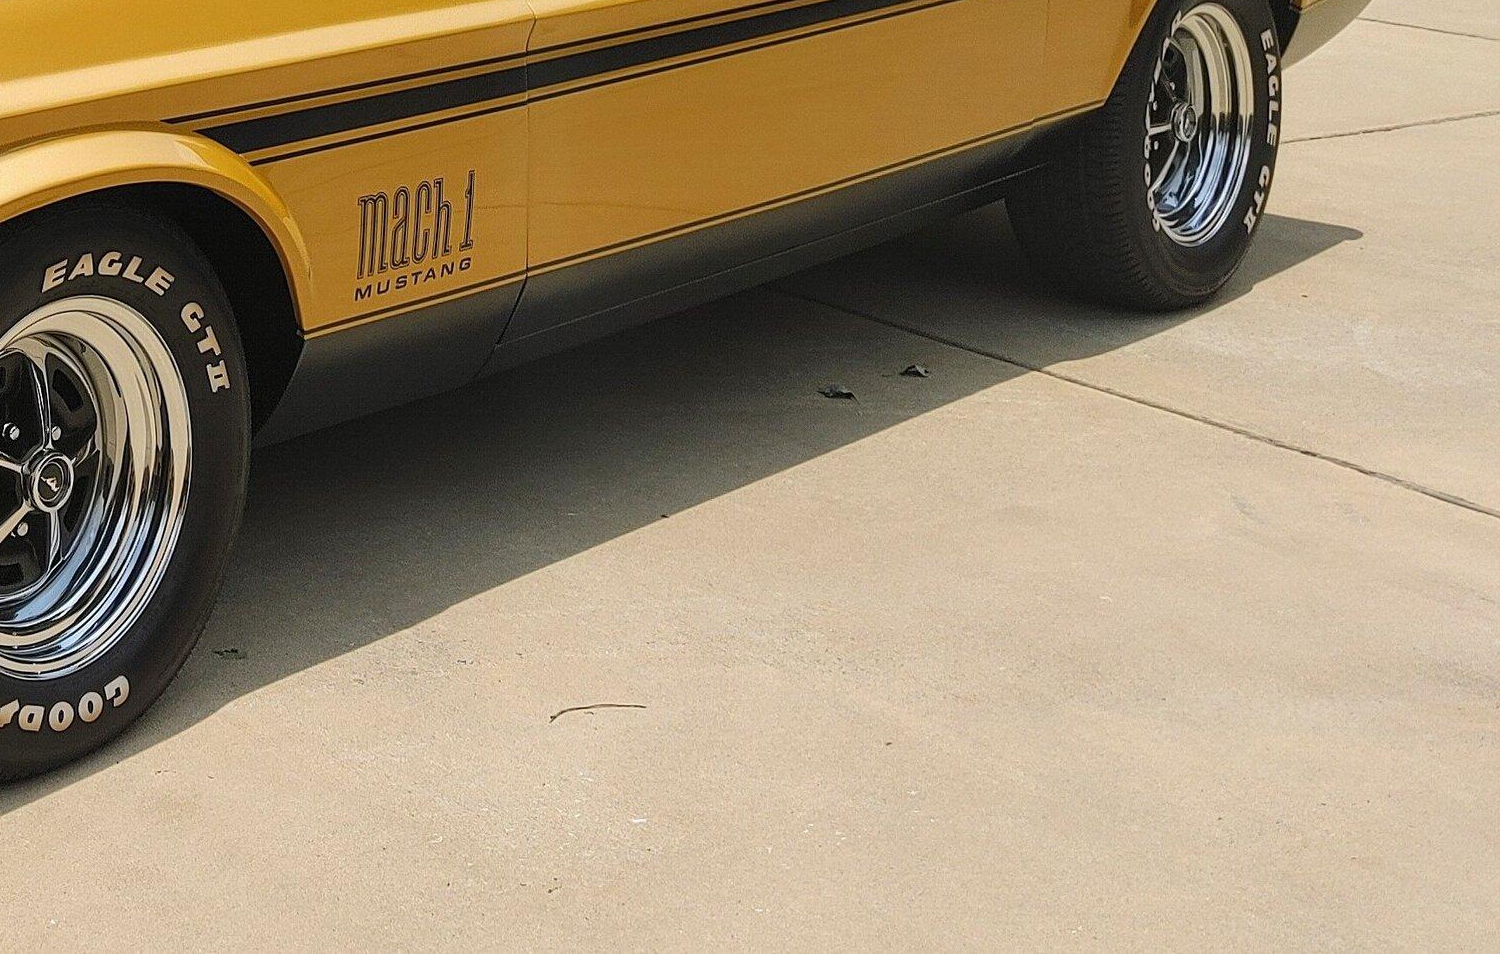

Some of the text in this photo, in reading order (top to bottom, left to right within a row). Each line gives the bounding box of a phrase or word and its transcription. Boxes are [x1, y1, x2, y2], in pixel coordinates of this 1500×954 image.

[1260, 28, 1278, 147] EAGLE
[356, 169, 476, 280] mach 1
[41, 250, 176, 297] EAGLE
[353, 256, 473, 302] MUSTANG
